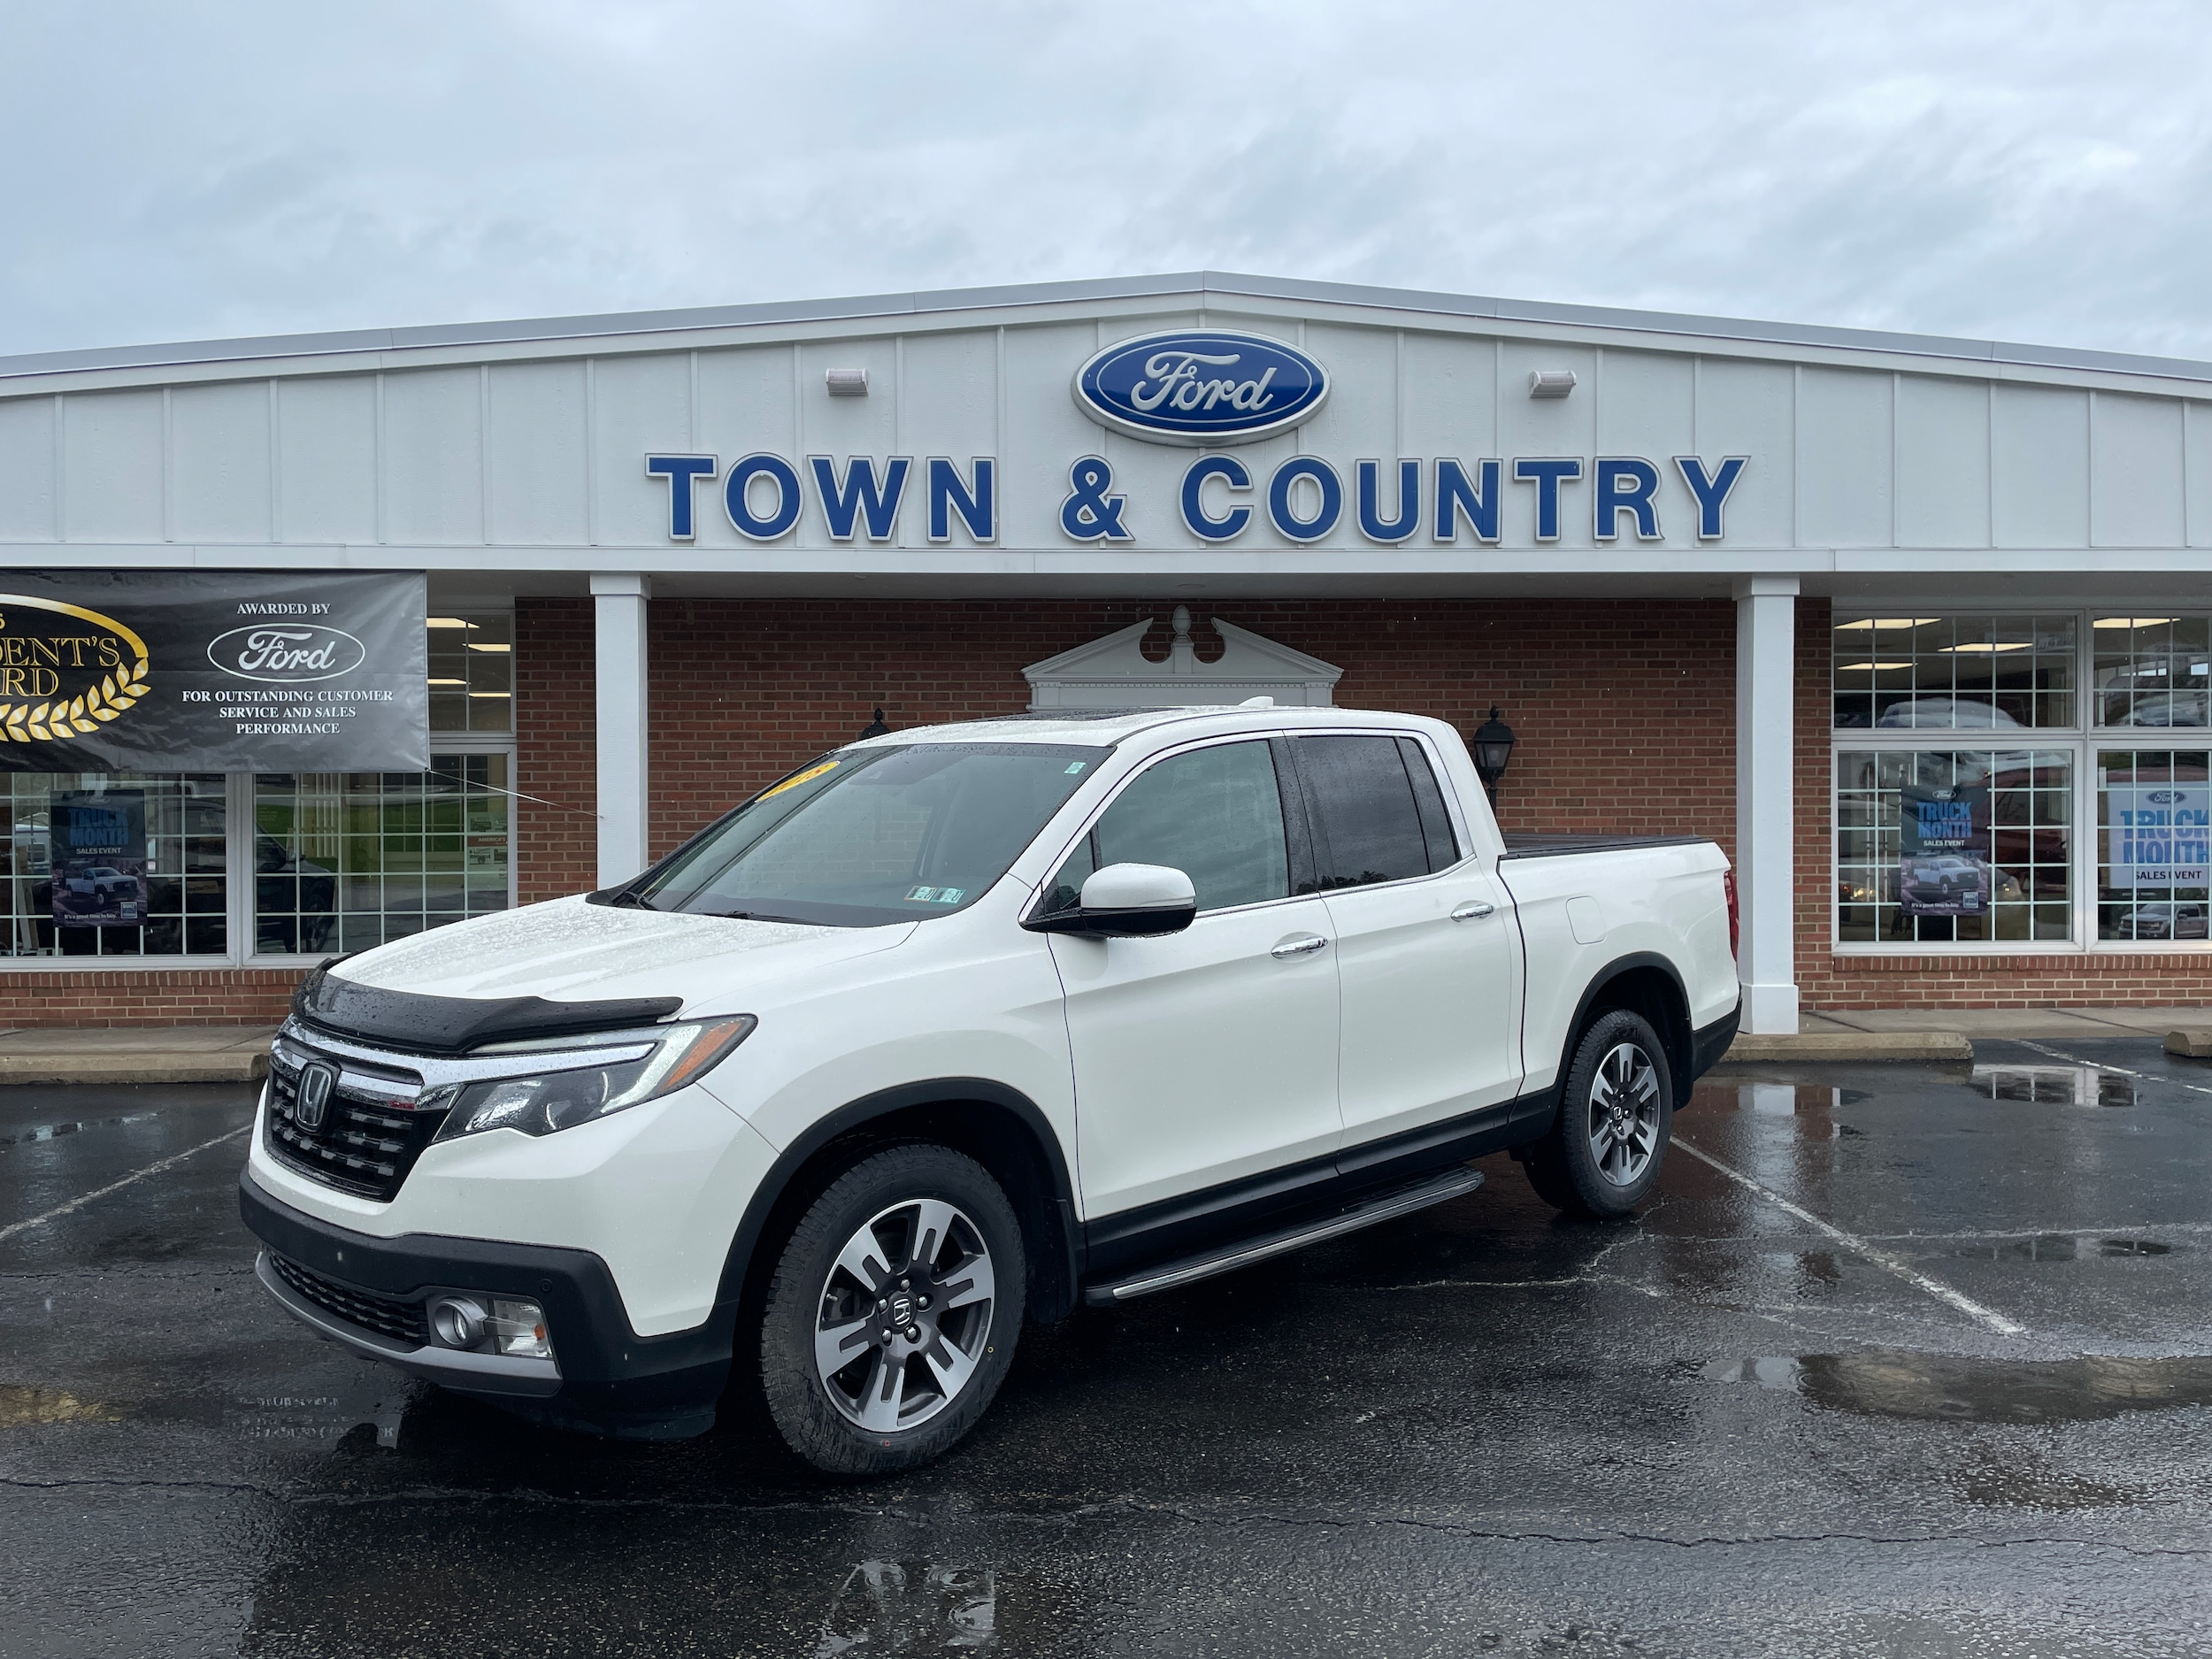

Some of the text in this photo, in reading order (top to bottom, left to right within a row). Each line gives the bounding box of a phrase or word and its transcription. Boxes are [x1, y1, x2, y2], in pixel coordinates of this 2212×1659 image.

[1129, 350, 1278, 412] Ford
[644, 452, 1751, 543] TOWN & COUNTRY
[237, 603, 331, 614] AWARDED BY
[0, 635, 120, 667] ENT'S
[238, 630, 336, 671] Ford
[182, 690, 393, 703] FOR OUTSTANDING CUSTOMER
[219, 706, 356, 718] SERVICE AND SALES
[236, 723, 341, 734] PERFORMANCE
[68, 808, 128, 826] TRUCK
[1916, 802, 1971, 820] TRUCK
[1918, 821, 1972, 838] MONTH
[2121, 809, 2209, 839] TRUCK
[70, 827, 129, 845] MONTH
[2136, 871, 2166, 879] SALES
